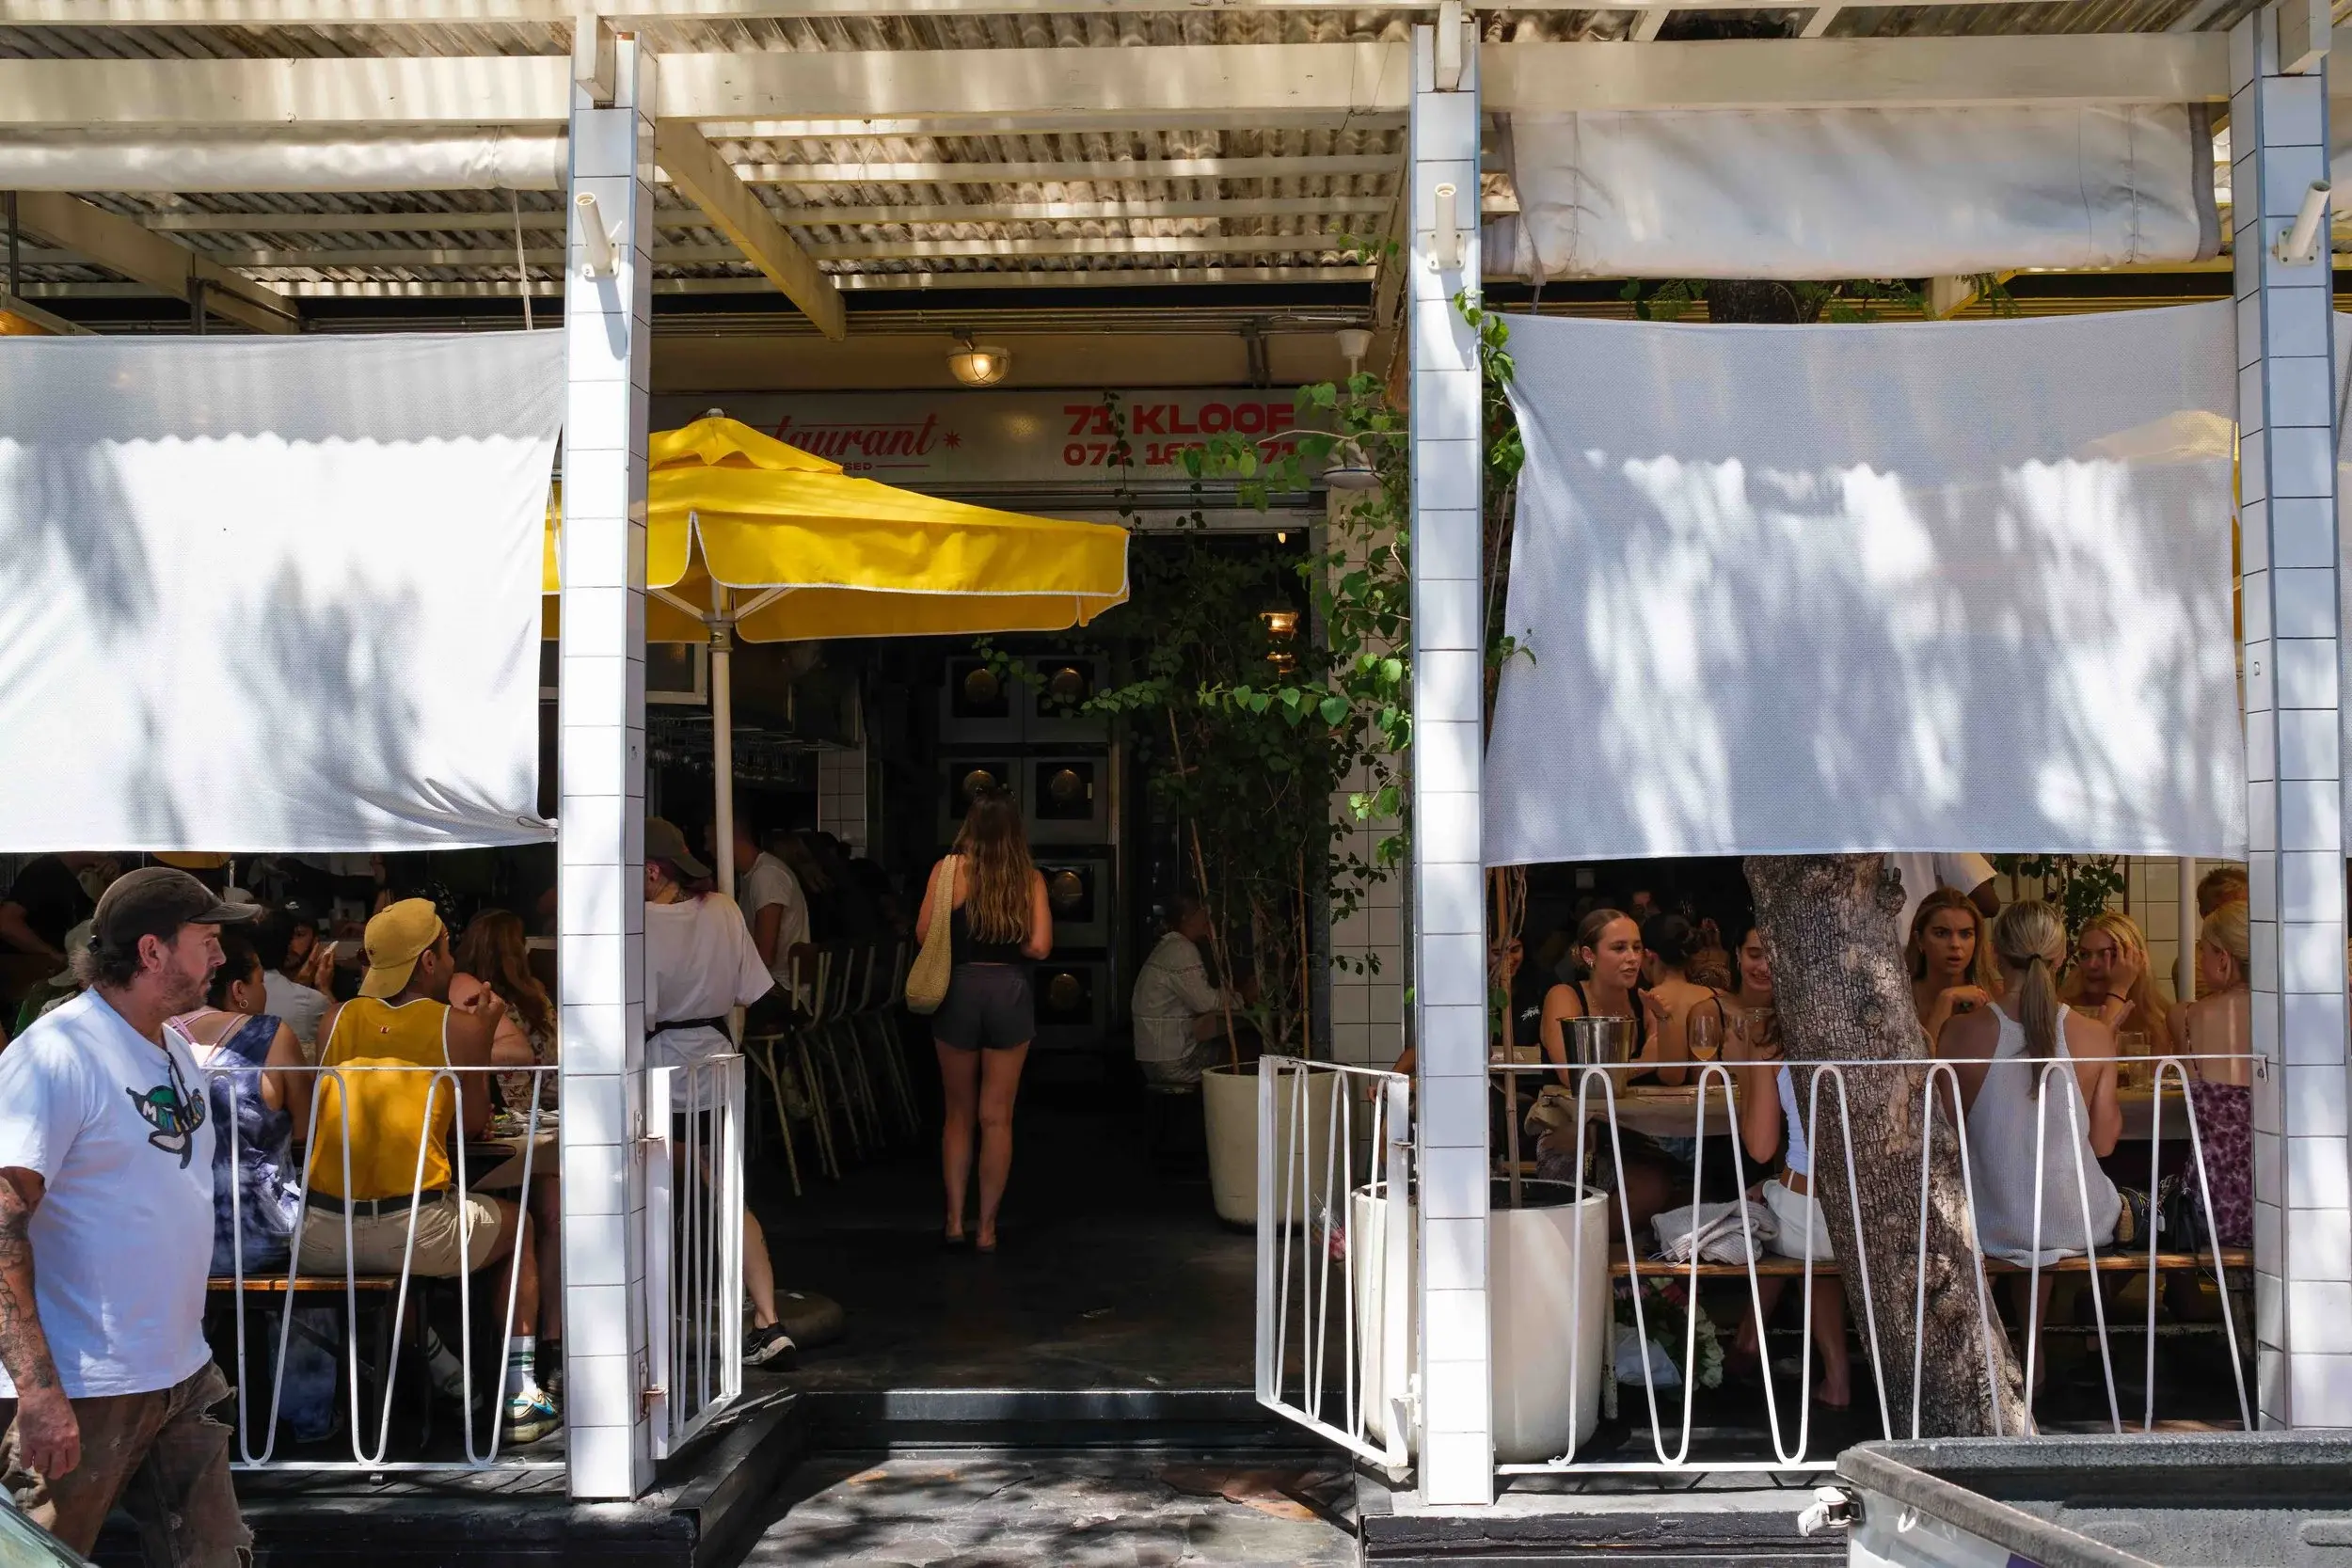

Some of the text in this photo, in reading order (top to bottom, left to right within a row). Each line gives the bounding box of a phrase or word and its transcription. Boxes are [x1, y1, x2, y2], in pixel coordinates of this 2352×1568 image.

[773, 412, 938, 457] taurant
[1063, 403, 1295, 436] 71 KLOOF
